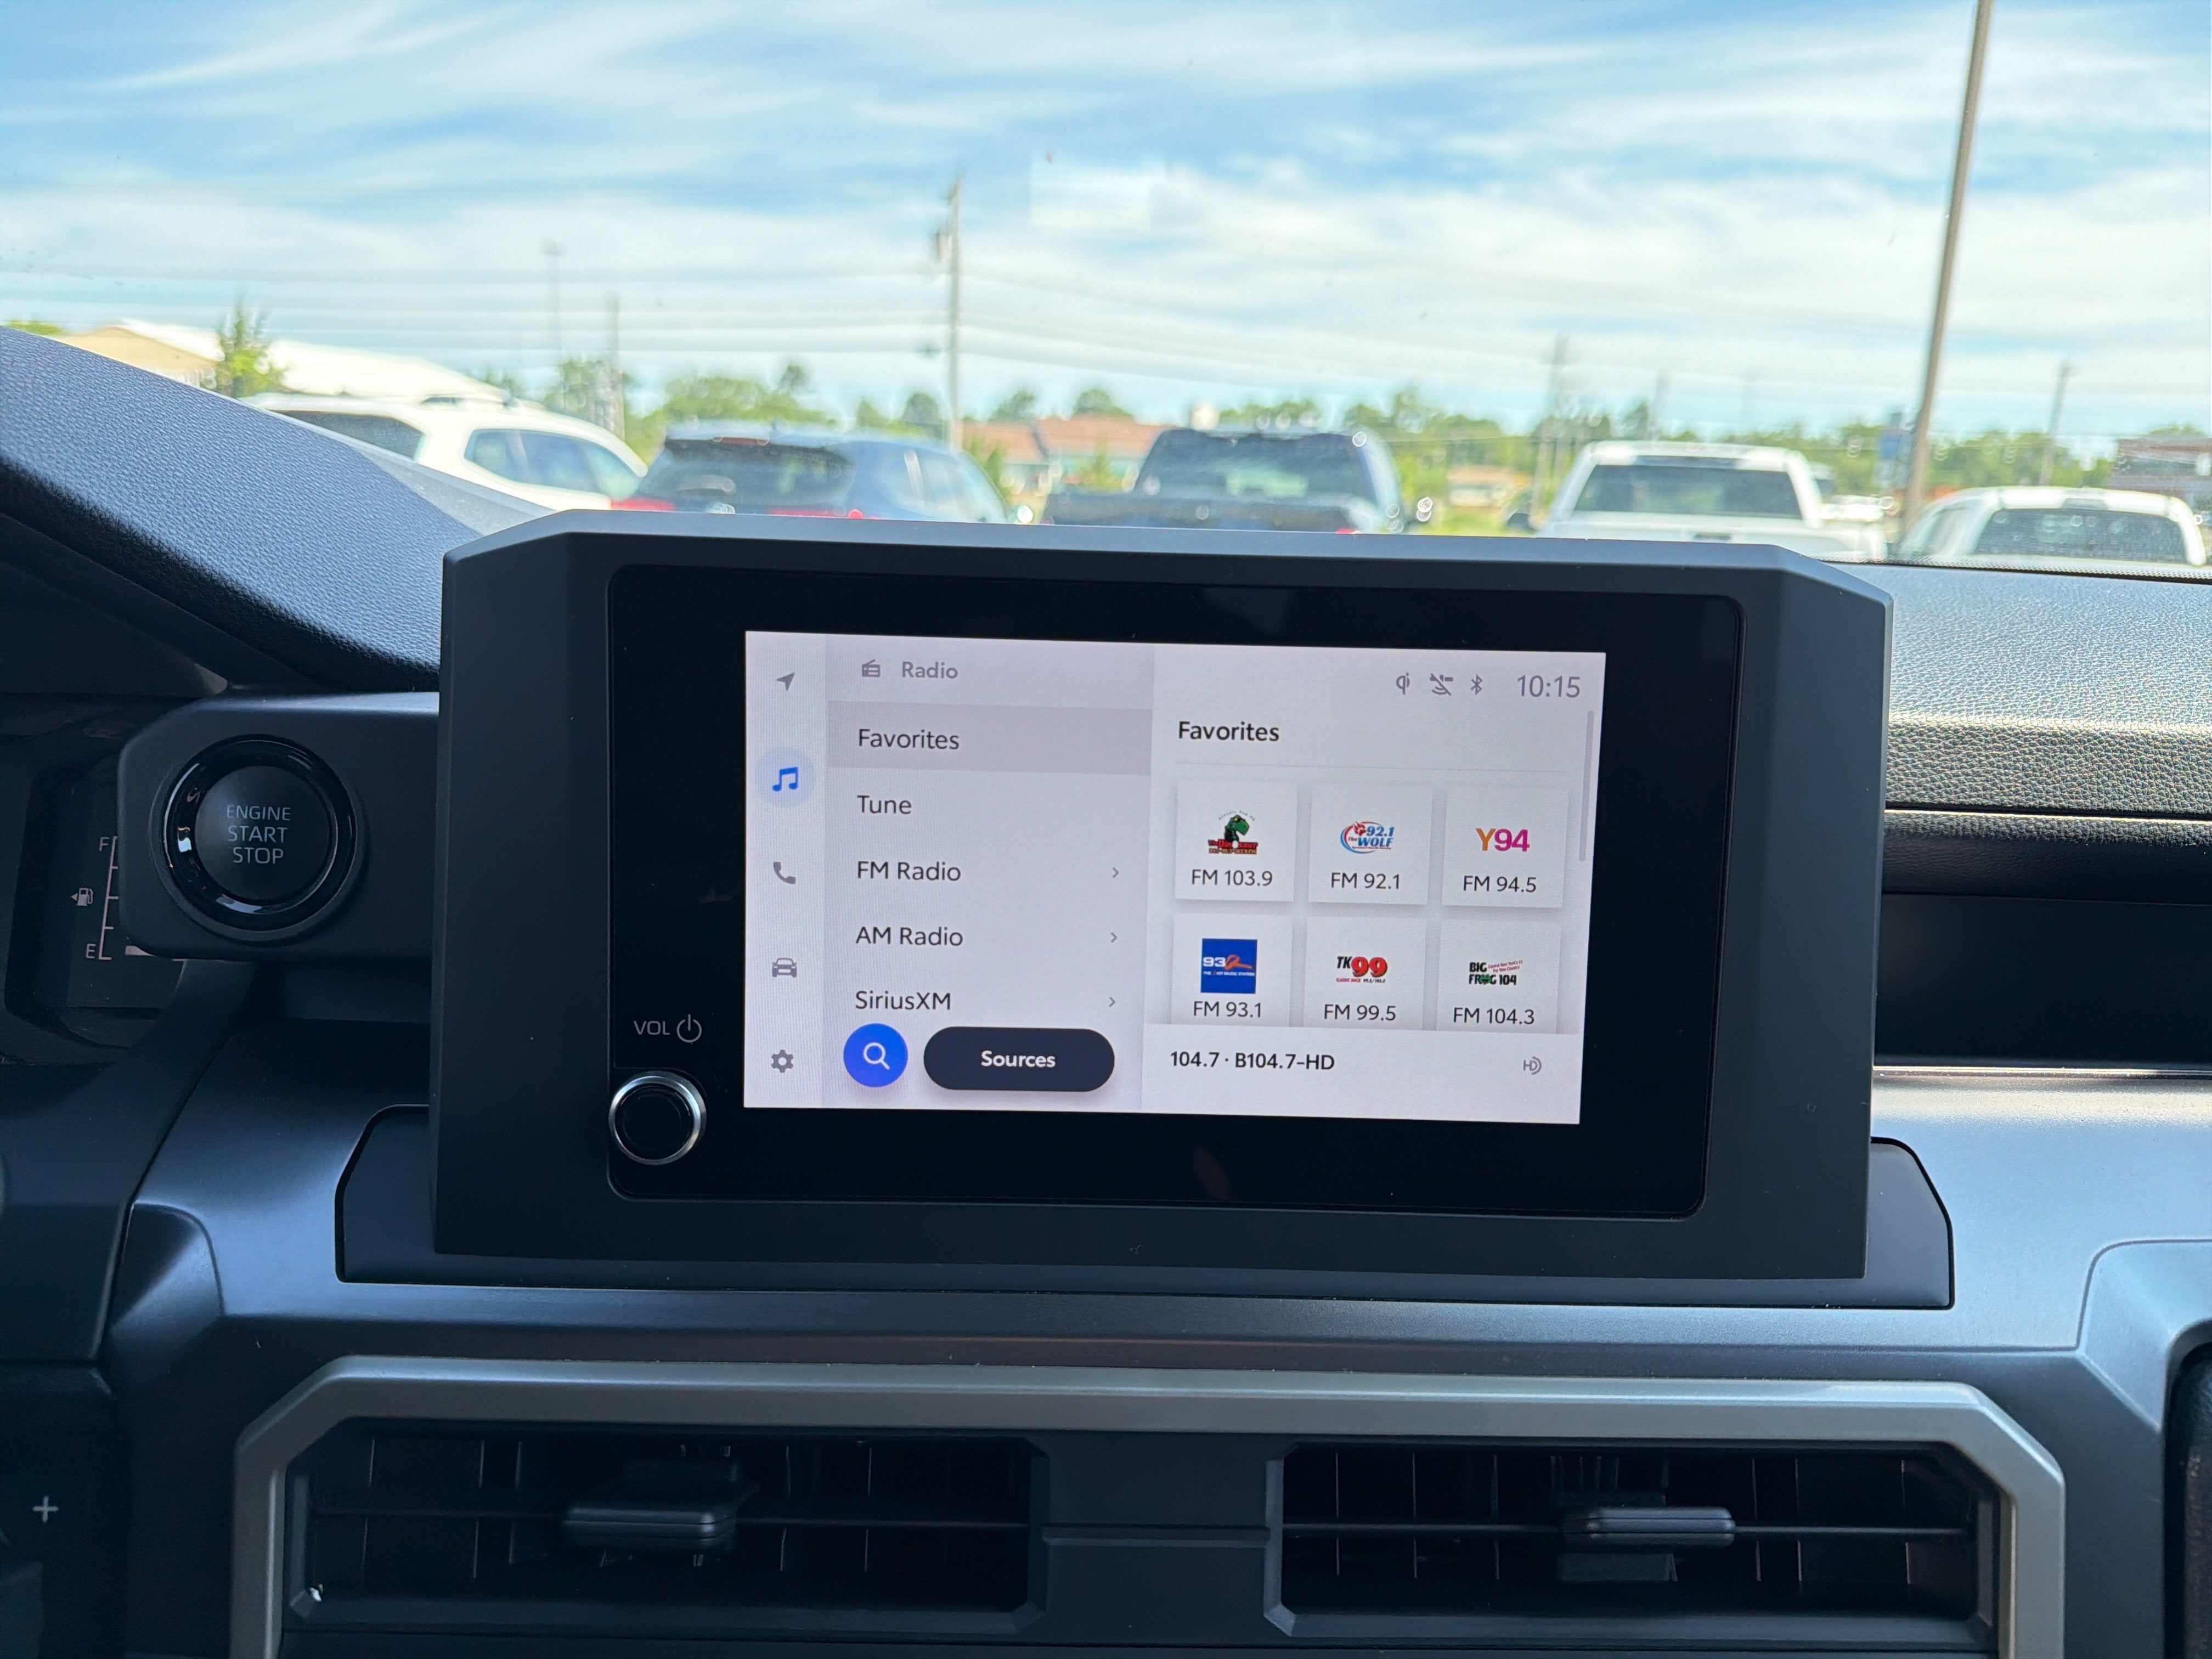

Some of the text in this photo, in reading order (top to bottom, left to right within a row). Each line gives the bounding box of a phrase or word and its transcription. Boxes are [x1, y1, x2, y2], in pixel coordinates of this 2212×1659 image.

[902, 661, 958, 679] Radio
[1517, 675, 1581, 698] 10:15
[859, 729, 960, 751] Favorites
[1178, 721, 1279, 742] Favorites
[227, 805, 291, 821] ENGINE
[857, 795, 912, 815] Tune
[228, 825, 288, 843] START
[1366, 826, 1395, 837] 92.1
[1475, 828, 1531, 852] Y94
[99, 837, 110, 851] F
[1358, 837, 1394, 848] WOLF
[233, 847, 284, 865] STOP
[857, 861, 961, 882] FM Radio
[1192, 869, 1273, 887] FM 103.9
[1331, 872, 1401, 889] FM 92.1
[1463, 875, 1537, 893] FM 94.5
[855, 926, 963, 946] AM Radio
[86, 943, 96, 960] E
[1337, 956, 1388, 978] TK99
[1469, 962, 1487, 973] BIG
[1499, 974, 1516, 986] 104
[855, 990, 951, 1010] SiriusXM
[1193, 1001, 1262, 1018] FM 93.1
[1324, 1004, 1396, 1021] FM 99.5
[1453, 1007, 1534, 1025] FM 104.3
[633, 1020, 670, 1035] VOL
[981, 1050, 1056, 1068] Sources
[1171, 1051, 1220, 1068] 104.7
[1235, 1052, 1335, 1070] B104.7-HD
